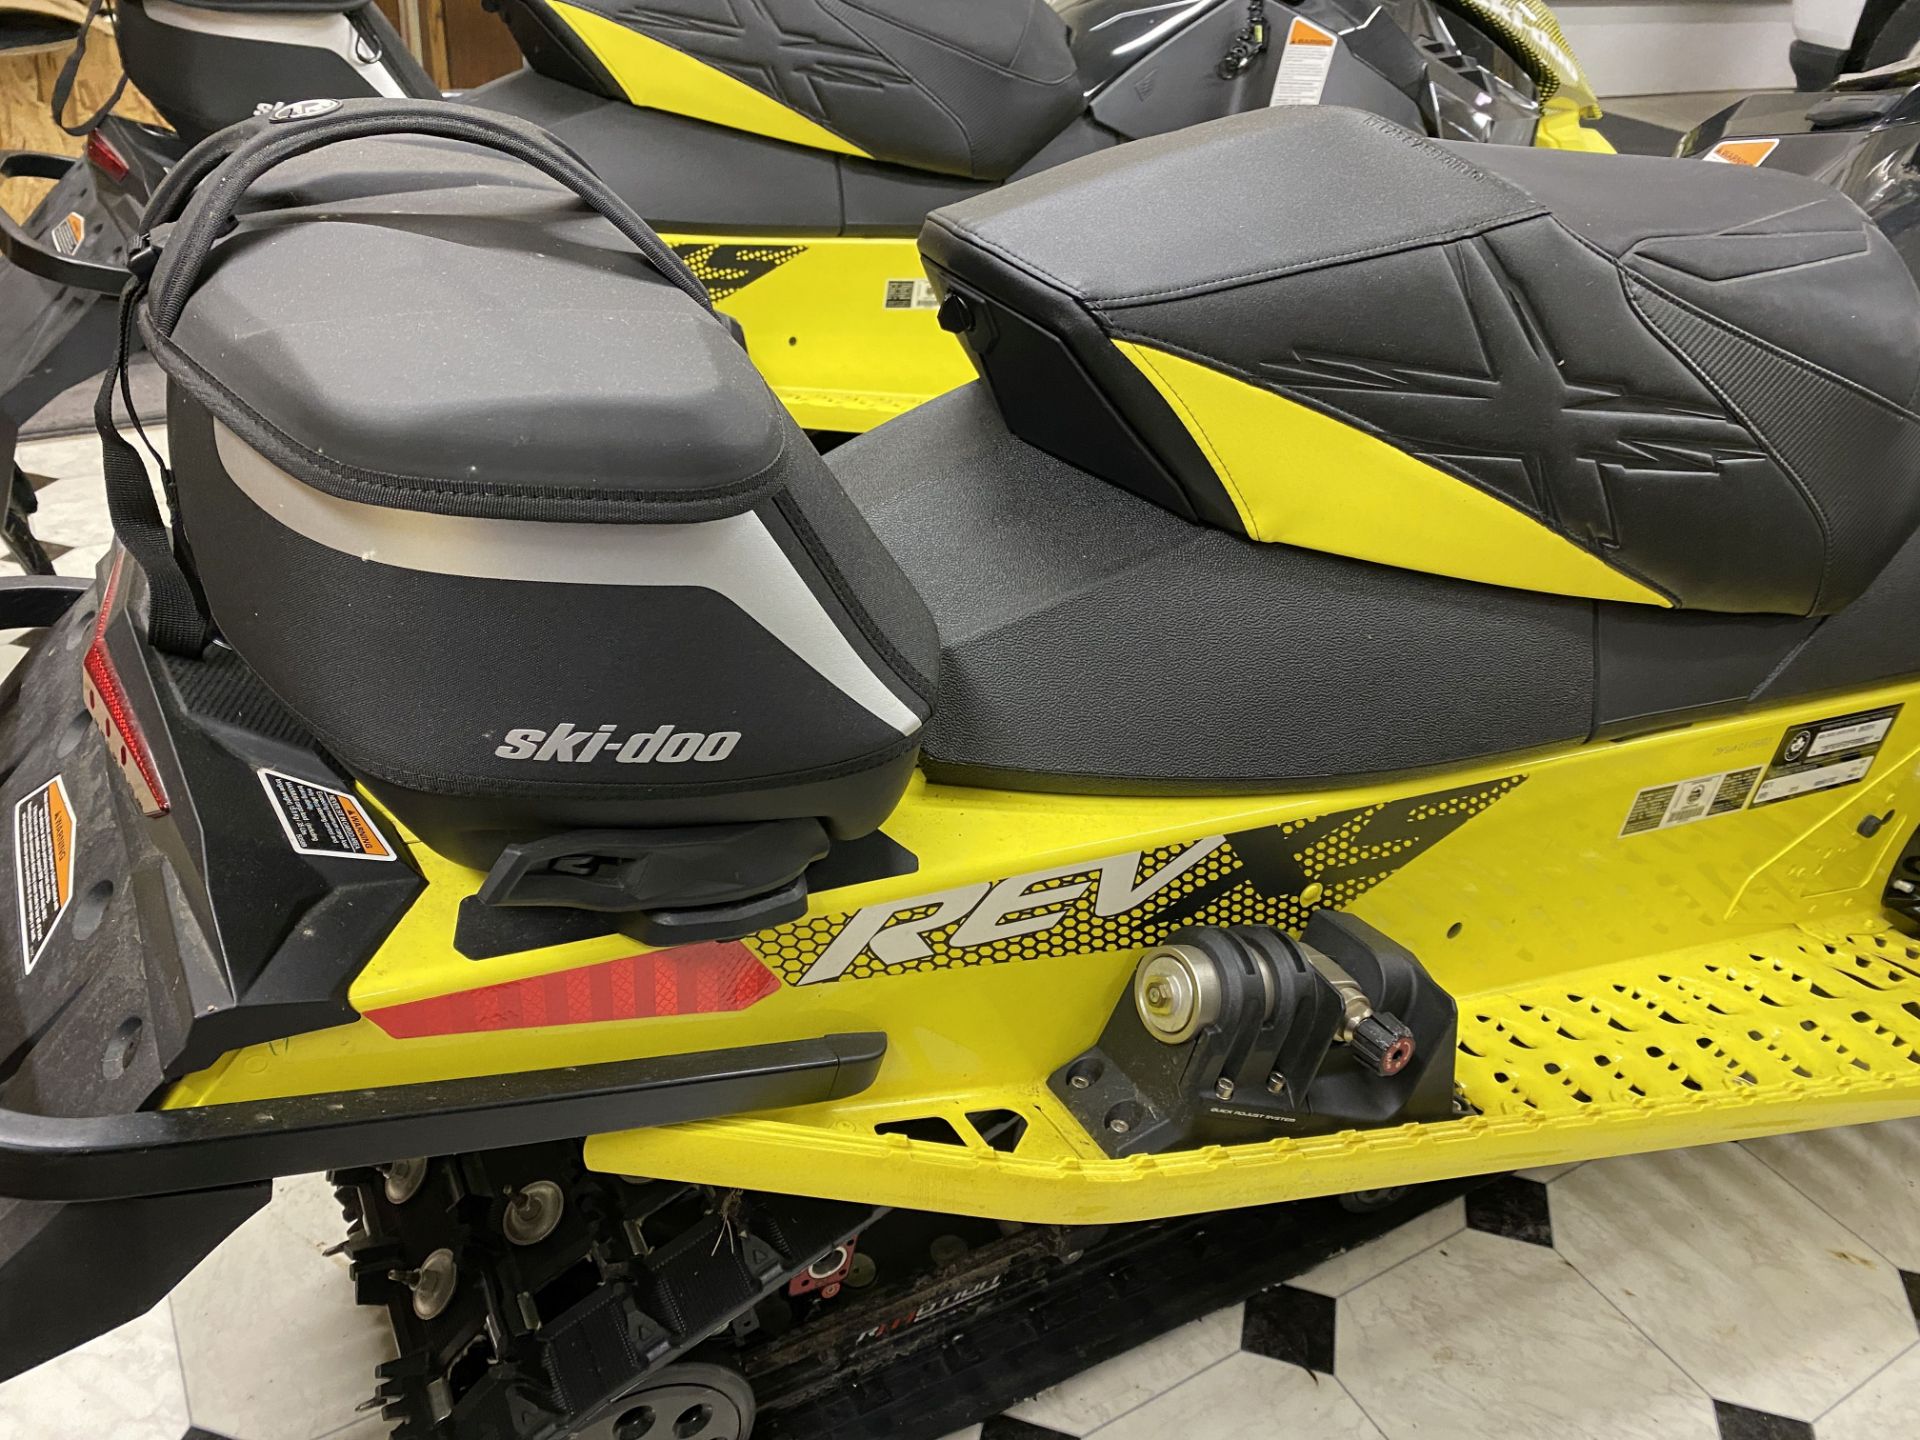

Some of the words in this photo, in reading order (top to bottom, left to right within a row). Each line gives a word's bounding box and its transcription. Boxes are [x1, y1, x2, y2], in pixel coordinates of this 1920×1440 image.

[495, 723, 742, 763] ski-doo
[55, 817, 69, 861] WARNING
[351, 815, 373, 849] WARNING
[797, 834, 1227, 986] REV
[1210, 1107, 1232, 1115] QUICK
[1233, 1110, 1264, 1118] ADJUST
[1265, 1114, 1296, 1122] SYSTEM
